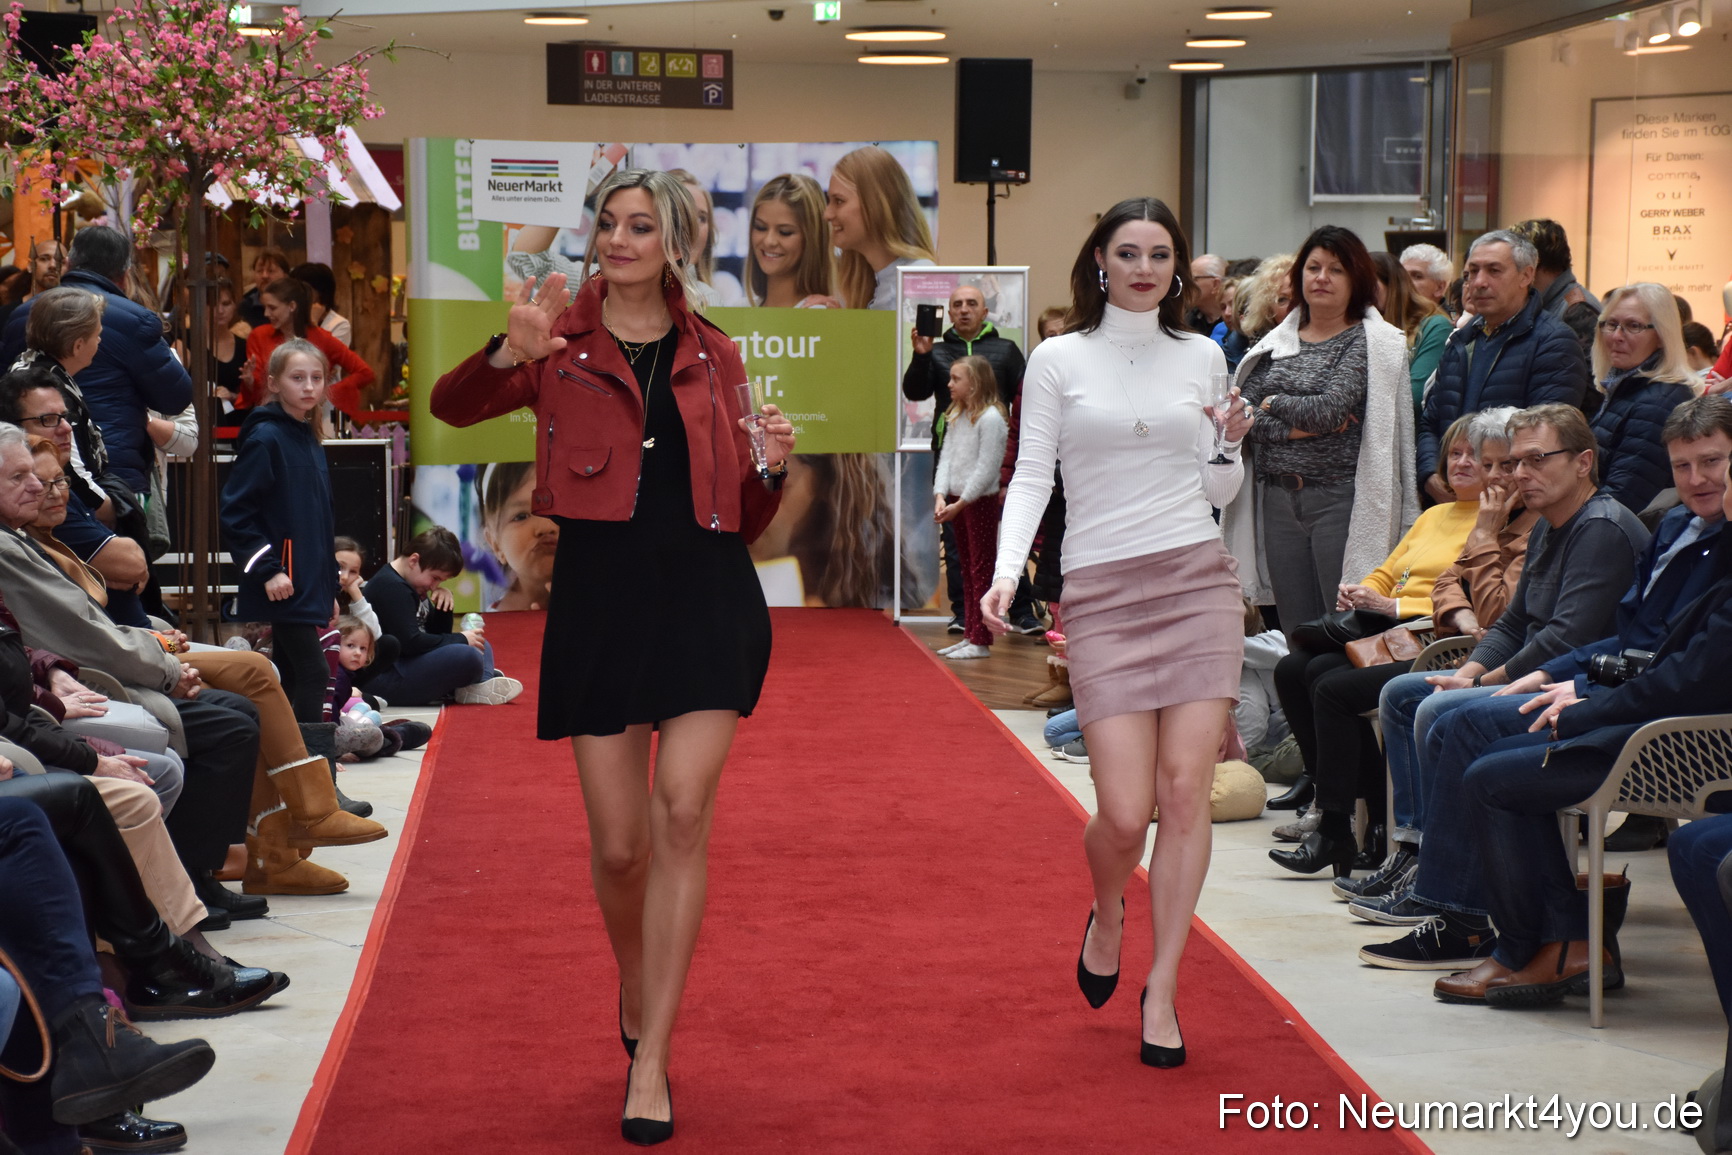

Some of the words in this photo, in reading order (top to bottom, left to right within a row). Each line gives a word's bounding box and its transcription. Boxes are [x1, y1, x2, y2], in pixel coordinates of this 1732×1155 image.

[584, 80, 594, 89] IN
[596, 80, 613, 90] DER
[616, 81, 662, 92] UNTEREN
[584, 93, 661, 104] LADENSTRASSE
[1636, 113, 1669, 125] Diese
[1673, 112, 1717, 123] Marken
[1622, 128, 1658, 140] finden
[1661, 127, 1680, 139] Sie
[1684, 127, 1698, 137] im
[1645, 152, 1662, 162] Für
[1666, 151, 1704, 161] Damen:
[487, 179, 563, 192] NeuerMarkt
[506, 195, 523, 203] unter
[523, 195, 543, 203] einem
[1640, 209, 1671, 218] GERRY
[1673, 208, 1705, 217] WEBER
[1653, 225, 1692, 235] BRAX
[1688, 283, 1712, 292] mehr
[731, 331, 821, 364] gtour
[522, 412, 537, 423] Sta
[784, 412, 828, 422] tronomie,
